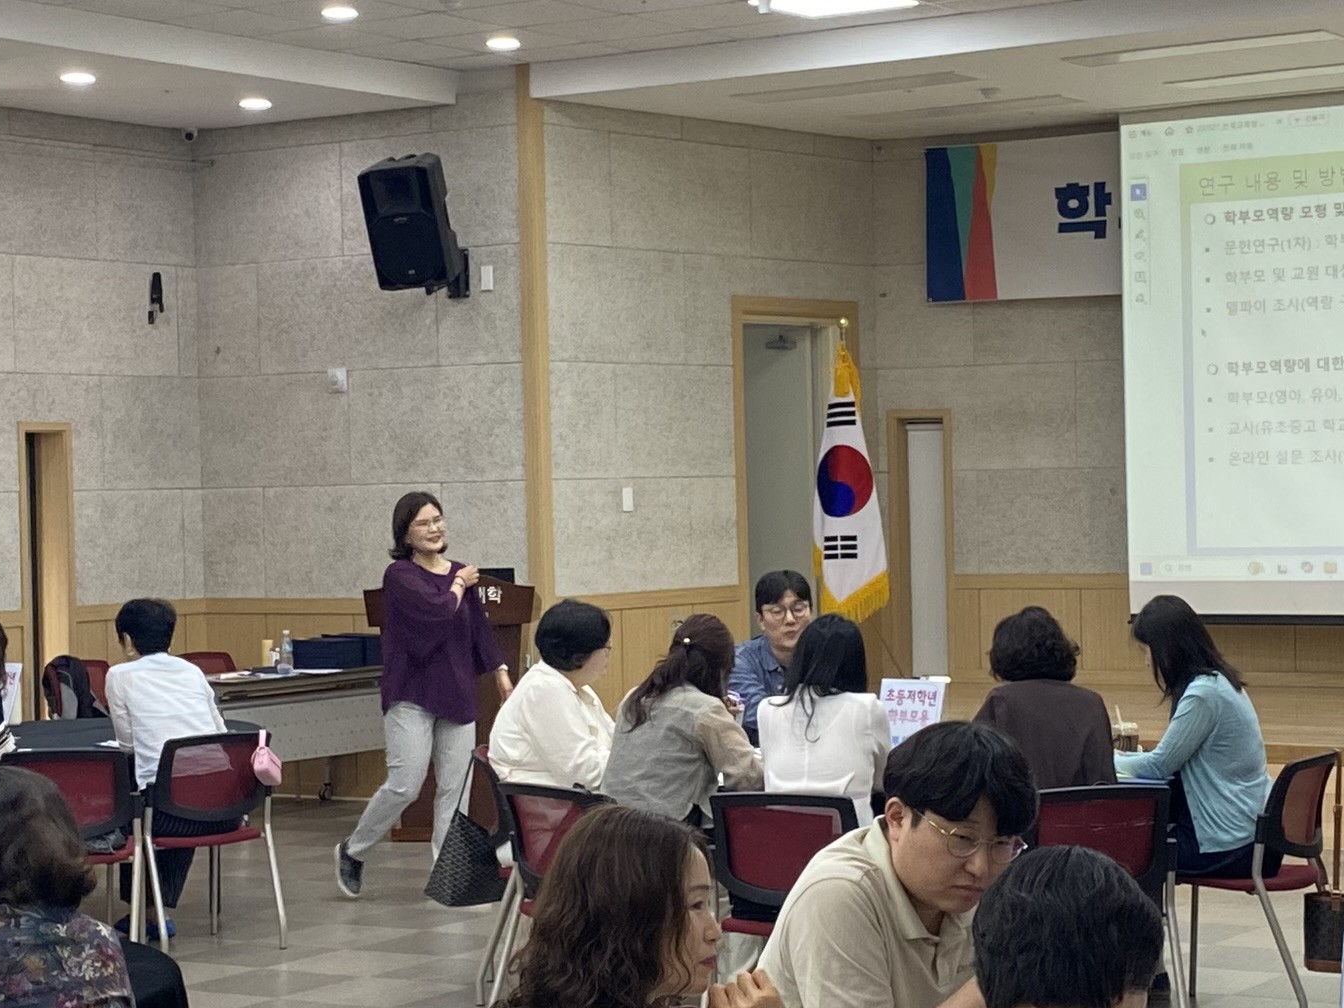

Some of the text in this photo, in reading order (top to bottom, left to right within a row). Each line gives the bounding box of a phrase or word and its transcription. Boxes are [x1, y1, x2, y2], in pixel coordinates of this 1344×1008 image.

[1198, 174, 1236, 197] 연구
[1244, 170, 1282, 193] 내용
[1291, 168, 1309, 190] 및
[1054, 182, 1121, 239] 학
[1222, 205, 1295, 226] 학부모역량
[1299, 201, 1328, 221] 모형
[1224, 268, 1267, 285] 학부모
[1291, 265, 1320, 282] 교원
[1226, 357, 1312, 377] 학부모역량에
[884, 688, 938, 707] 초등저학년
[888, 708, 930, 727] 학부모용
